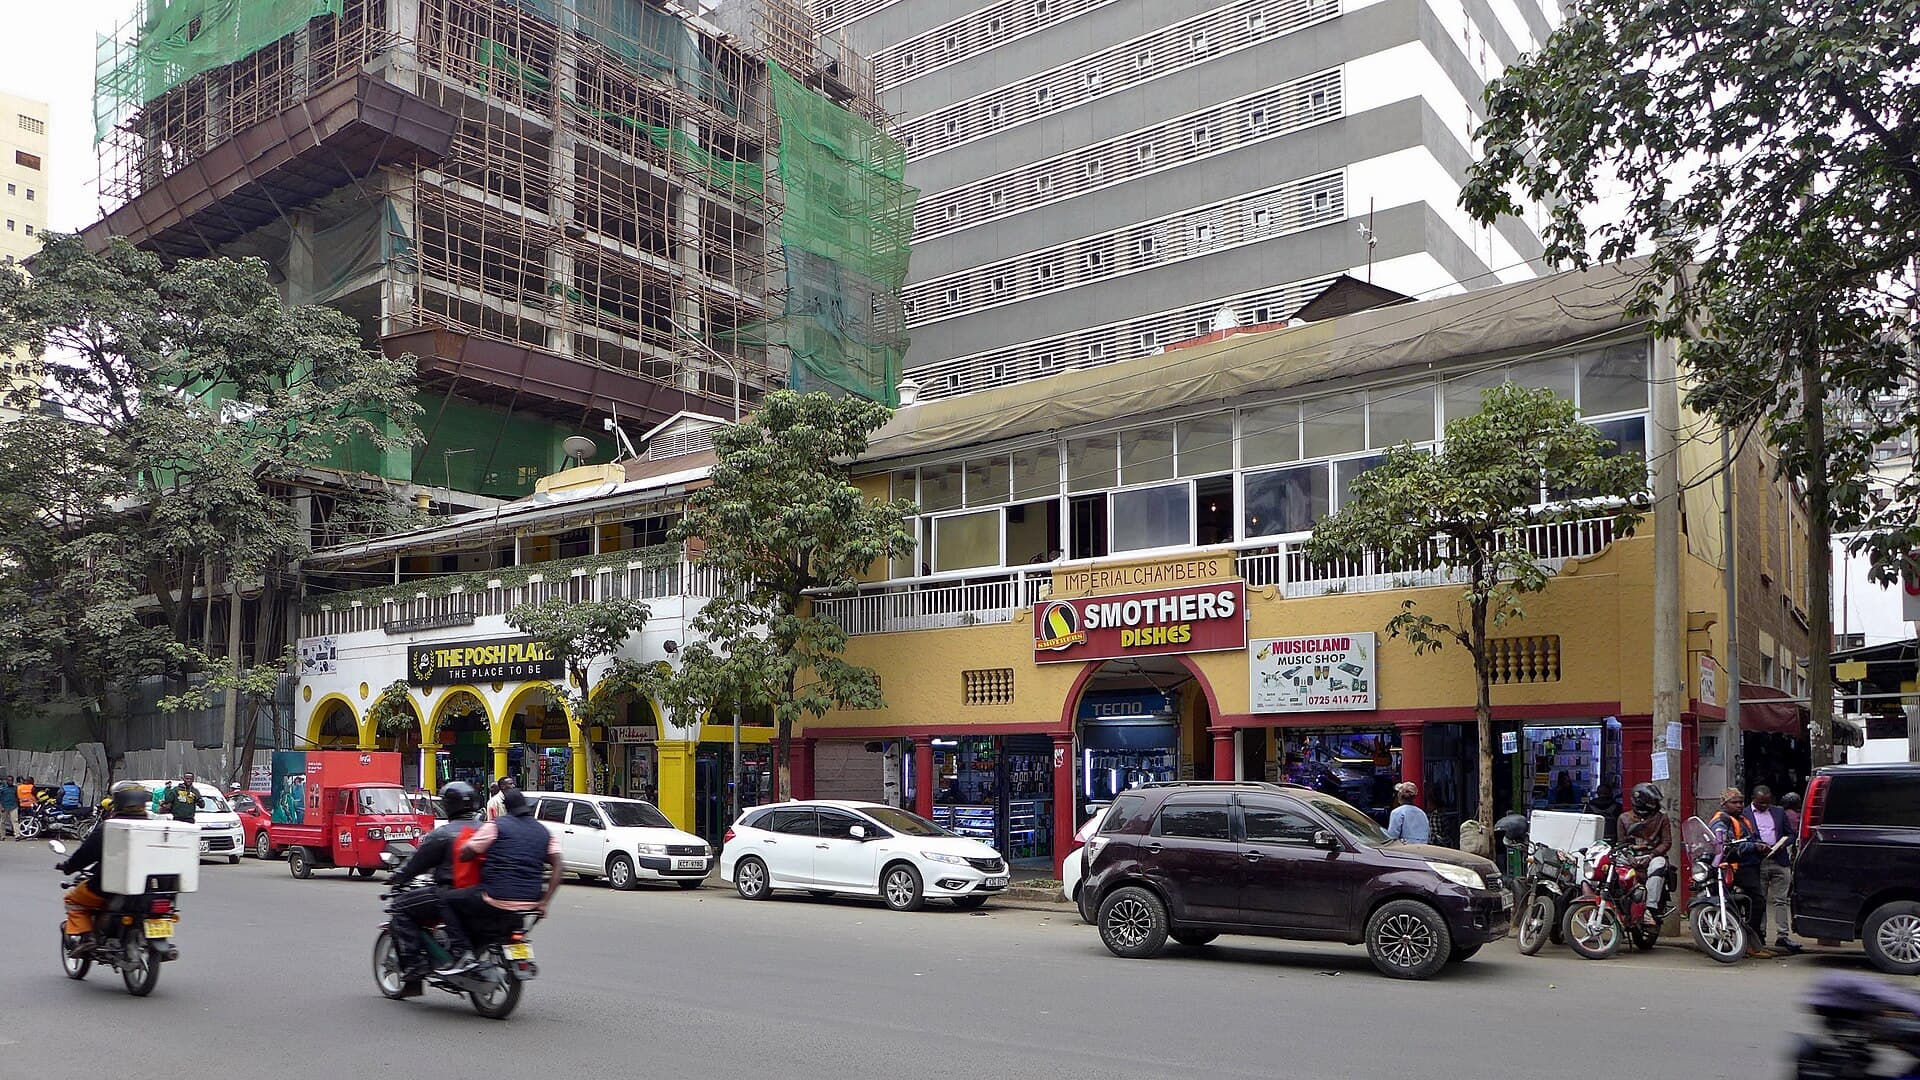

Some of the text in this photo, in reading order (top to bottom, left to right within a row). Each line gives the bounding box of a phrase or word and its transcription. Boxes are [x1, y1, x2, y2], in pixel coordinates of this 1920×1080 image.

[1083, 591, 1235, 629] SMOTHERS
[1037, 633, 1083, 648] SMOTHERS
[1121, 624, 1191, 648] DISHES
[1272, 637, 1351, 655] MUSICLAND
[435, 648, 464, 669] THE
[465, 645, 506, 666] POSH
[1277, 653, 1346, 666] MUSIC SHOP
[449, 664, 541, 679] THE PLACE TO BE
[1308, 696, 1329, 705] 0725
[1332, 695, 1349, 704] 414
[1351, 694, 1368, 704] 772
[1092, 702, 1143, 716] TECNO
